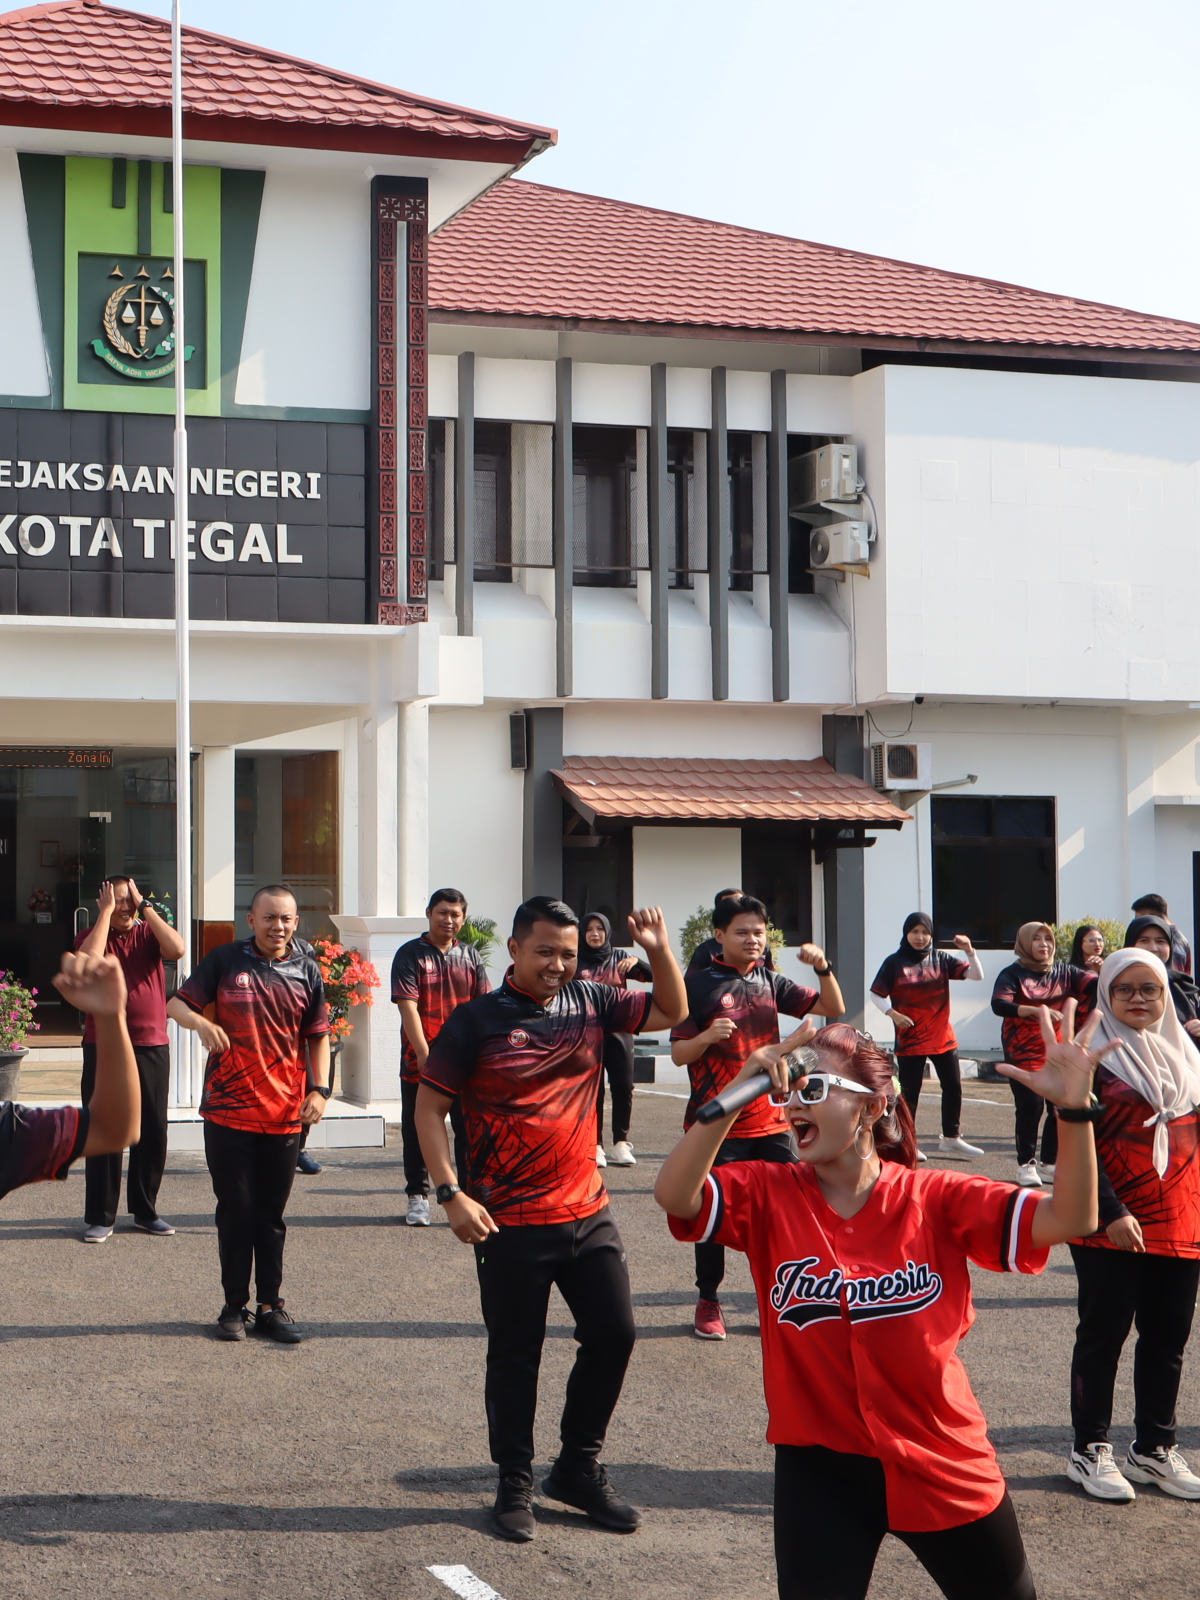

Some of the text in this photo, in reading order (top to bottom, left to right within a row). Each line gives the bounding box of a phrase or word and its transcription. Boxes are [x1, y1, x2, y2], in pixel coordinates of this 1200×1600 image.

[105, 353, 124, 371] SATYA
[125, 367, 142, 377] ADHI
[190, 467, 321, 499] NEGERI
[68, 752, 97, 763] Zona
[771, 1257, 931, 1312] Indonesia
